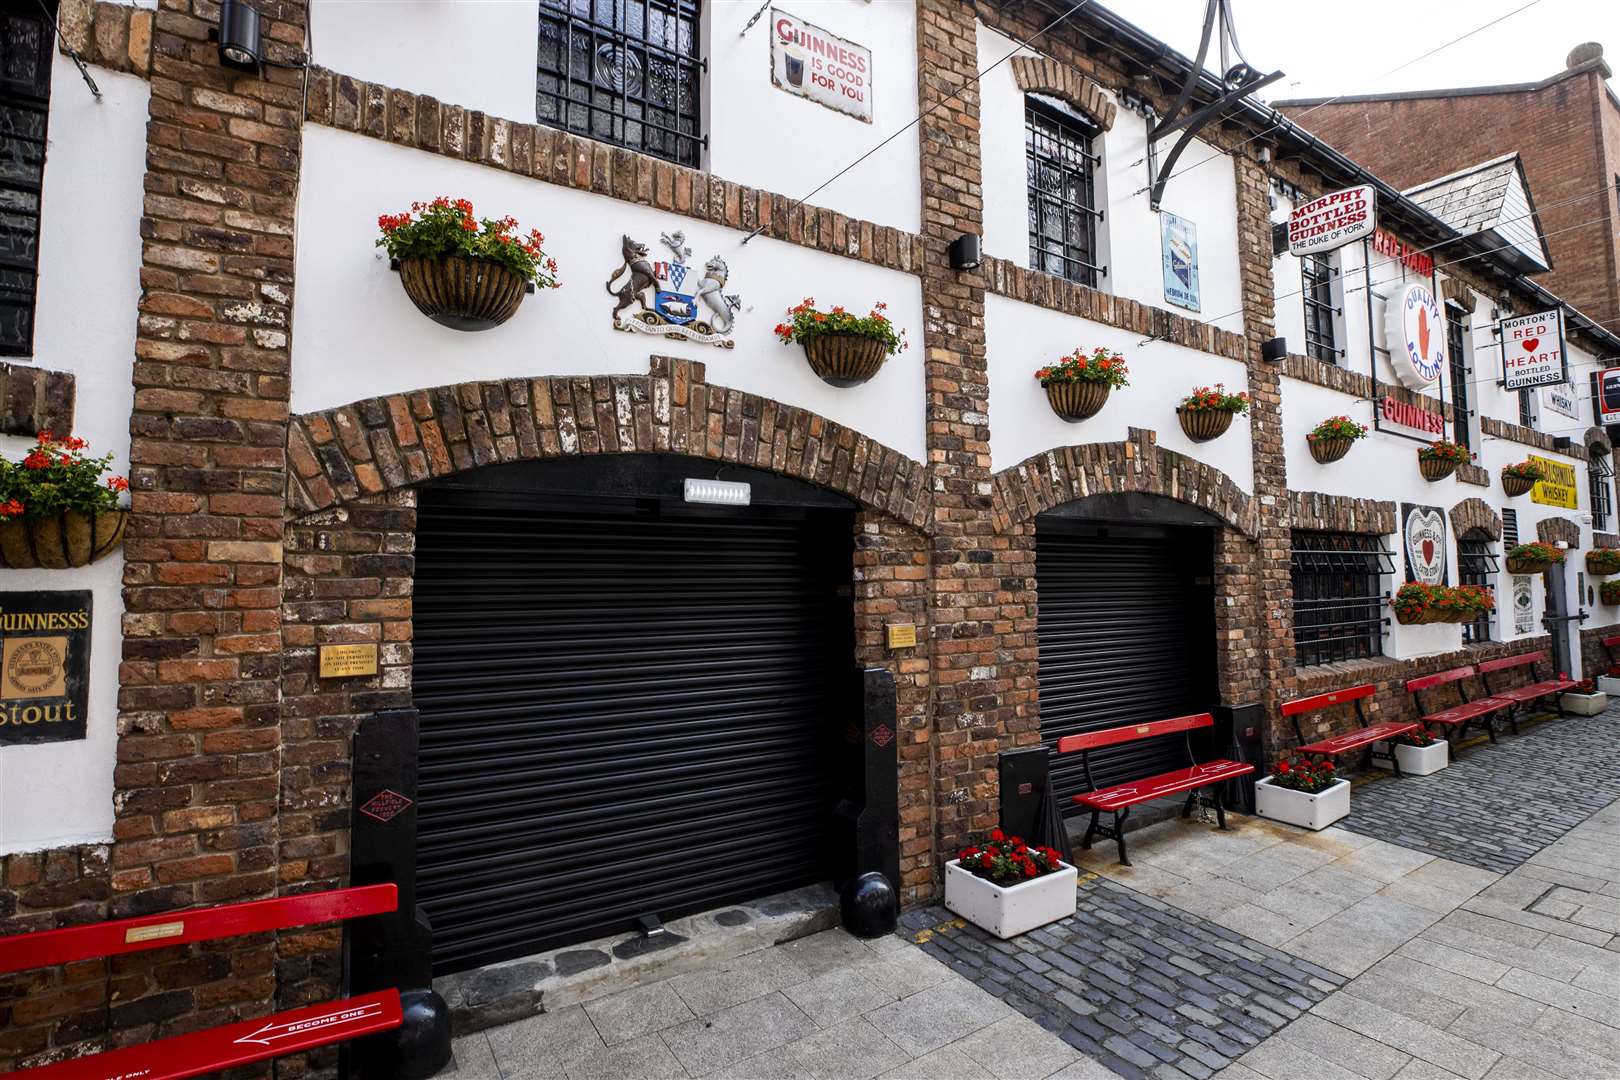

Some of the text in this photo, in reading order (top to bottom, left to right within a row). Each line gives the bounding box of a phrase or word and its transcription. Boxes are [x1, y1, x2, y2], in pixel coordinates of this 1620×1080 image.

[776, 19, 866, 73] GUINNESS
[811, 56, 863, 87] IS GOOD
[811, 72, 864, 102] FOR YOU
[1290, 200, 1366, 232] BOTTLED
[1292, 188, 1365, 221] MURPHY
[1290, 210, 1367, 242] GUINNESS
[1293, 222, 1366, 250] THE DUKE OF YORK
[1373, 226, 1436, 279] RED HAND
[1407, 288, 1440, 318] QUALITY
[1504, 312, 1556, 329] MORTON'S
[1514, 325, 1546, 339] RED
[1408, 341, 1443, 380] BOTTLING
[1505, 350, 1559, 368] HEART
[1515, 365, 1550, 377] BOTTLED
[1508, 372, 1560, 388] GUINNESS
[1382, 395, 1445, 435] GUINNESS
[1551, 391, 1573, 412] WHISKY
[1542, 483, 1568, 503] WHISKEY
[288, 1009, 364, 1032] BECOME ONE
[125, 1069, 151, 1079] ONLY
